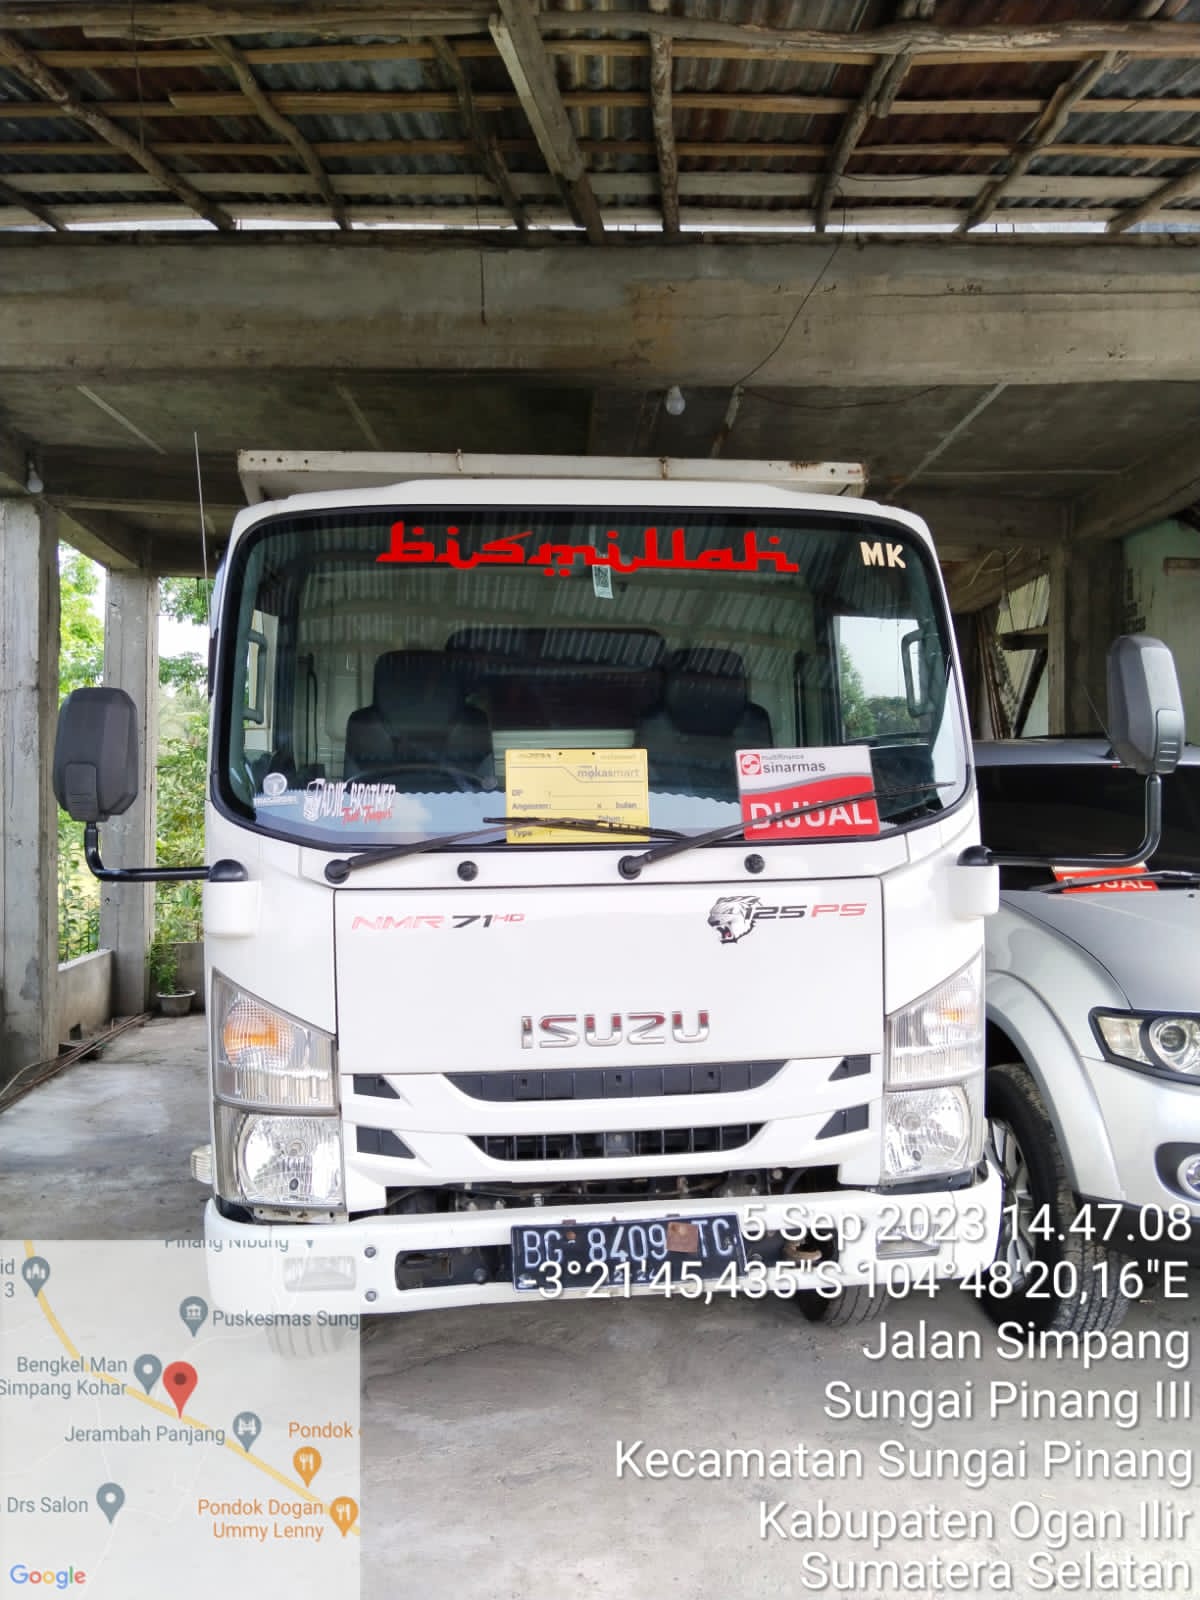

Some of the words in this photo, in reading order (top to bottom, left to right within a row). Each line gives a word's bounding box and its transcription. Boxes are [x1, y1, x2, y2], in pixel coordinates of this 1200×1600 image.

[376, 521, 799, 577] bismillah
[860, 541, 906, 568] MK
[763, 762, 826, 774] sinarmas
[750, 800, 873, 830] DIJUAL
[352, 916, 445, 930] NMR
[811, 903, 867, 917] PS
[521, 1010, 710, 1049] ISUZU
[523, 1230, 563, 1268] BG
[587, 1223, 668, 1262] 8409
[690, 1218, 733, 1258] TC
